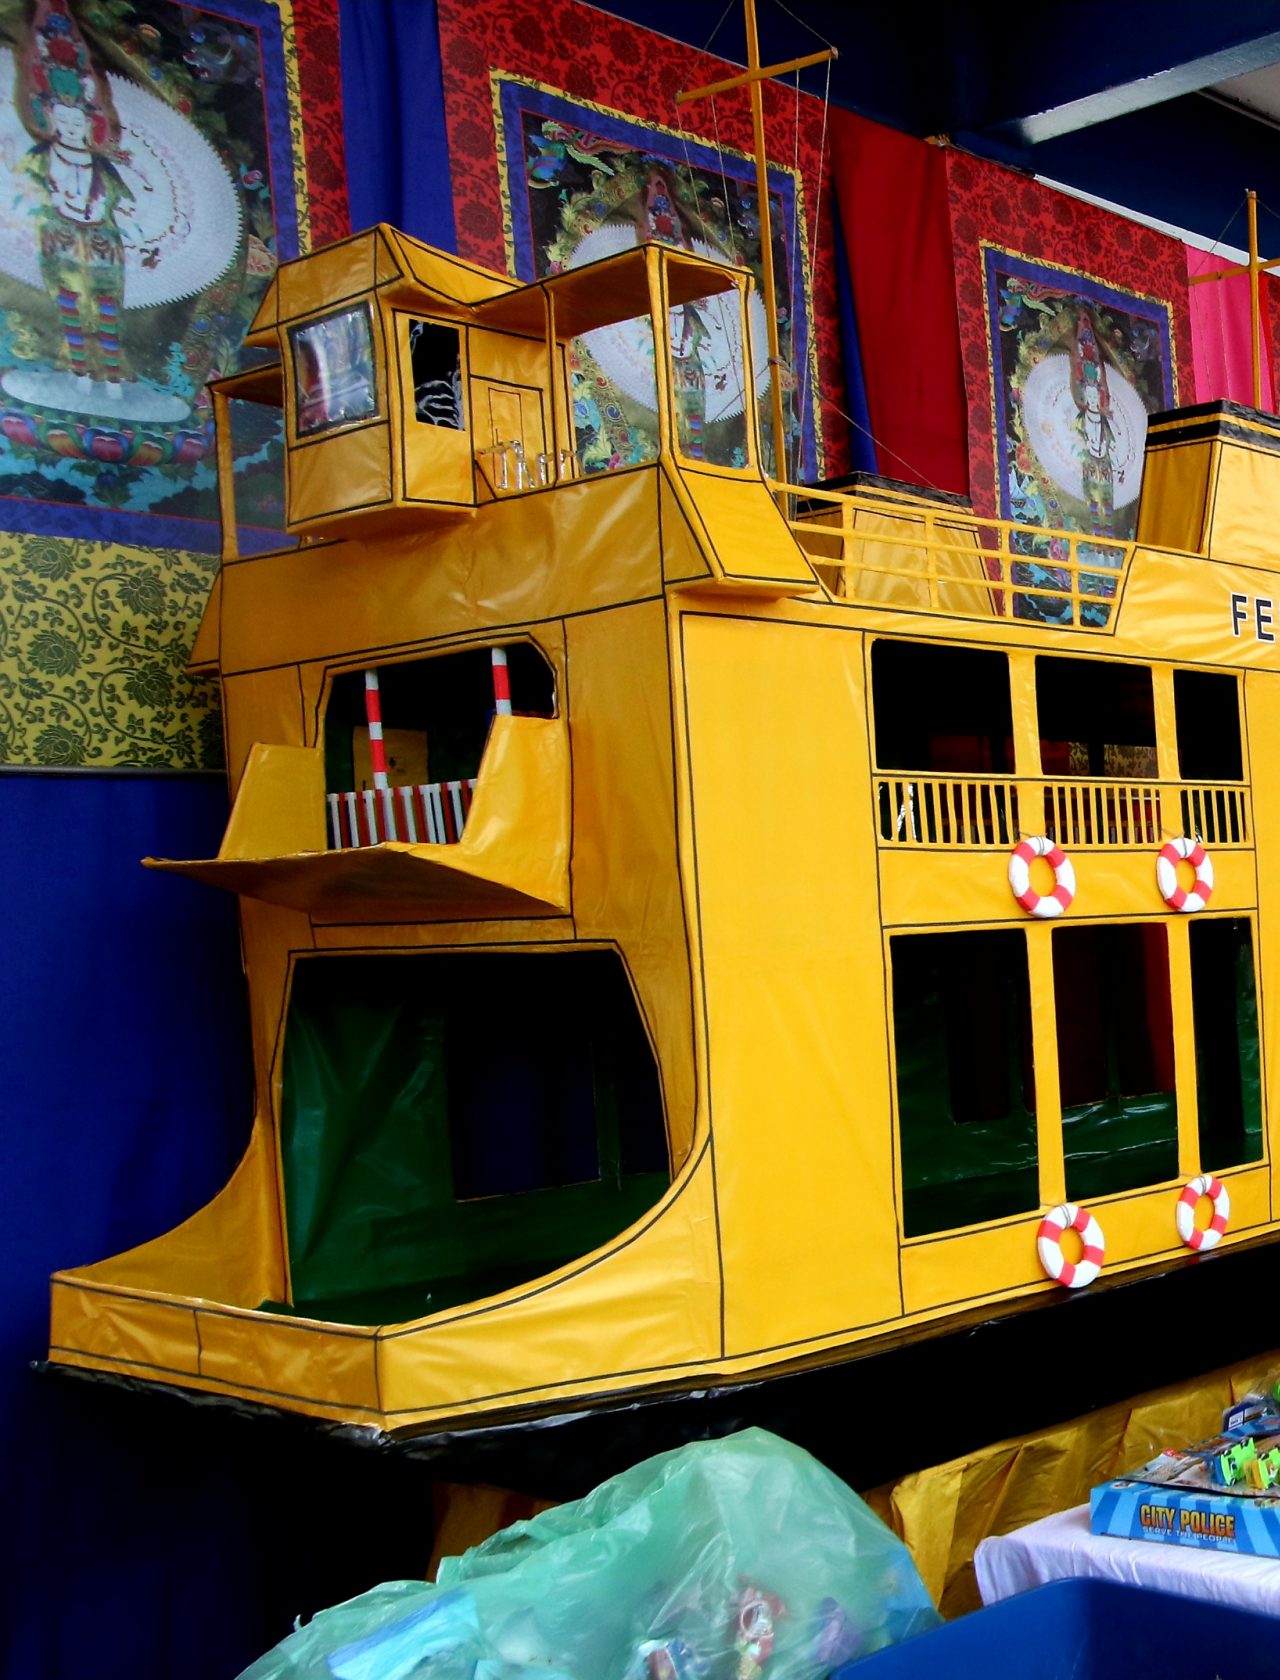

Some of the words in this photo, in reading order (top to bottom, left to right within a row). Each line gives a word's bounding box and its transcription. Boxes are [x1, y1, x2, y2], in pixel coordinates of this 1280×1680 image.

[1140, 1504, 1175, 1529] CITY
[1180, 1509, 1236, 1538] POLICE
[1143, 1526, 1172, 1537] SERVE
